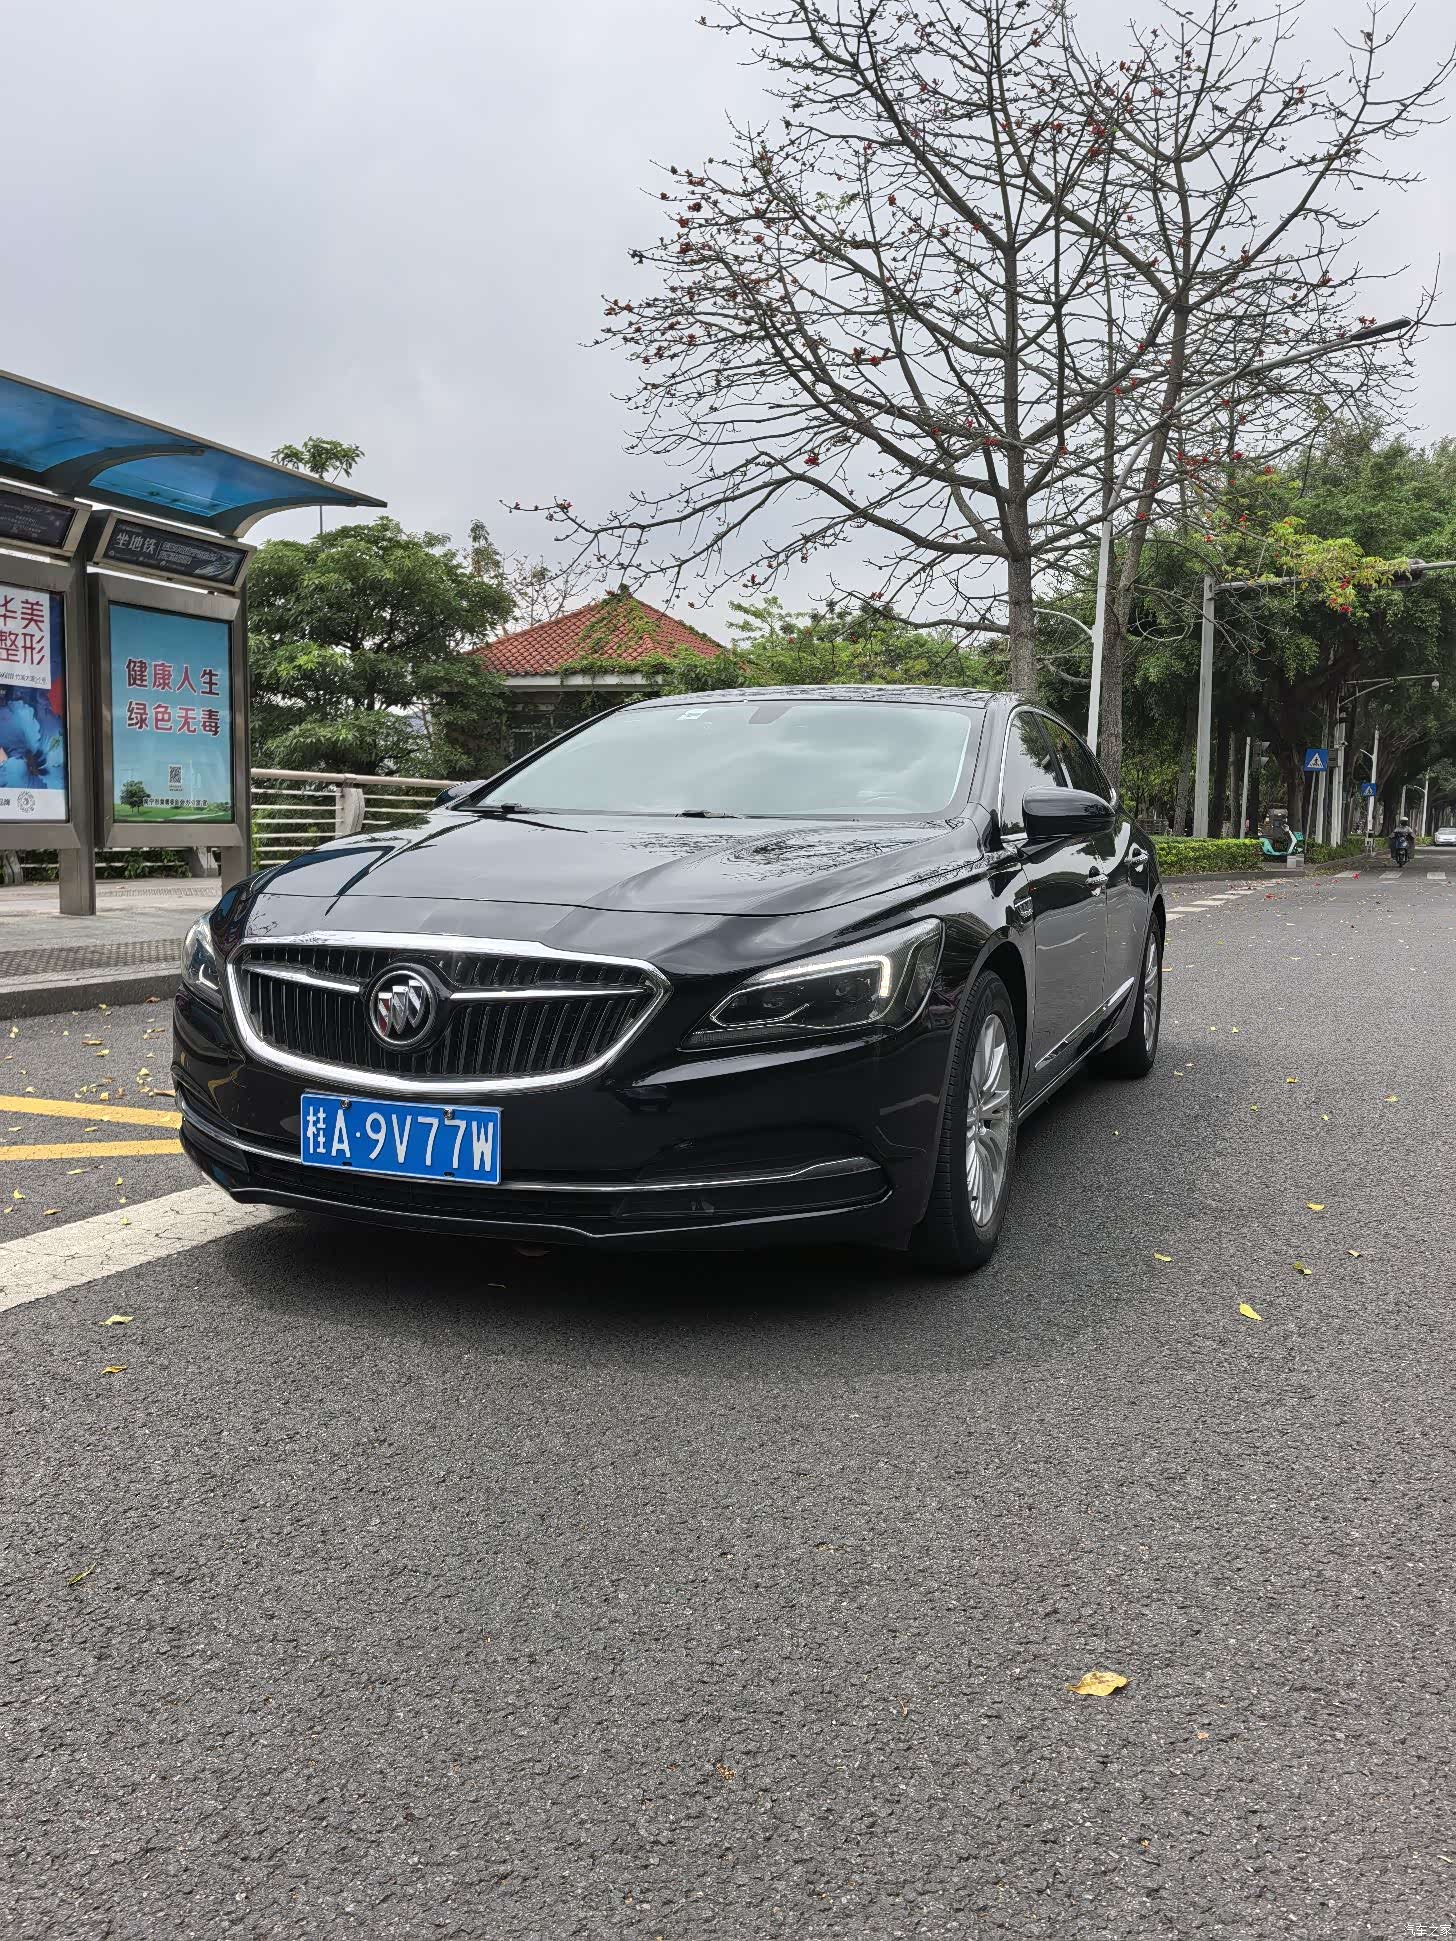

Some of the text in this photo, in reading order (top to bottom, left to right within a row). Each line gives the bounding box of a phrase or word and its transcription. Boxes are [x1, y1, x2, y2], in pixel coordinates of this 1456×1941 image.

[114, 532, 157, 554] 坐地铁
[0, 594, 44, 632] 华美
[0, 629, 45, 666] 整形
[126, 658, 220, 697] 健康人生
[126, 700, 221, 737] 绿色无毒
